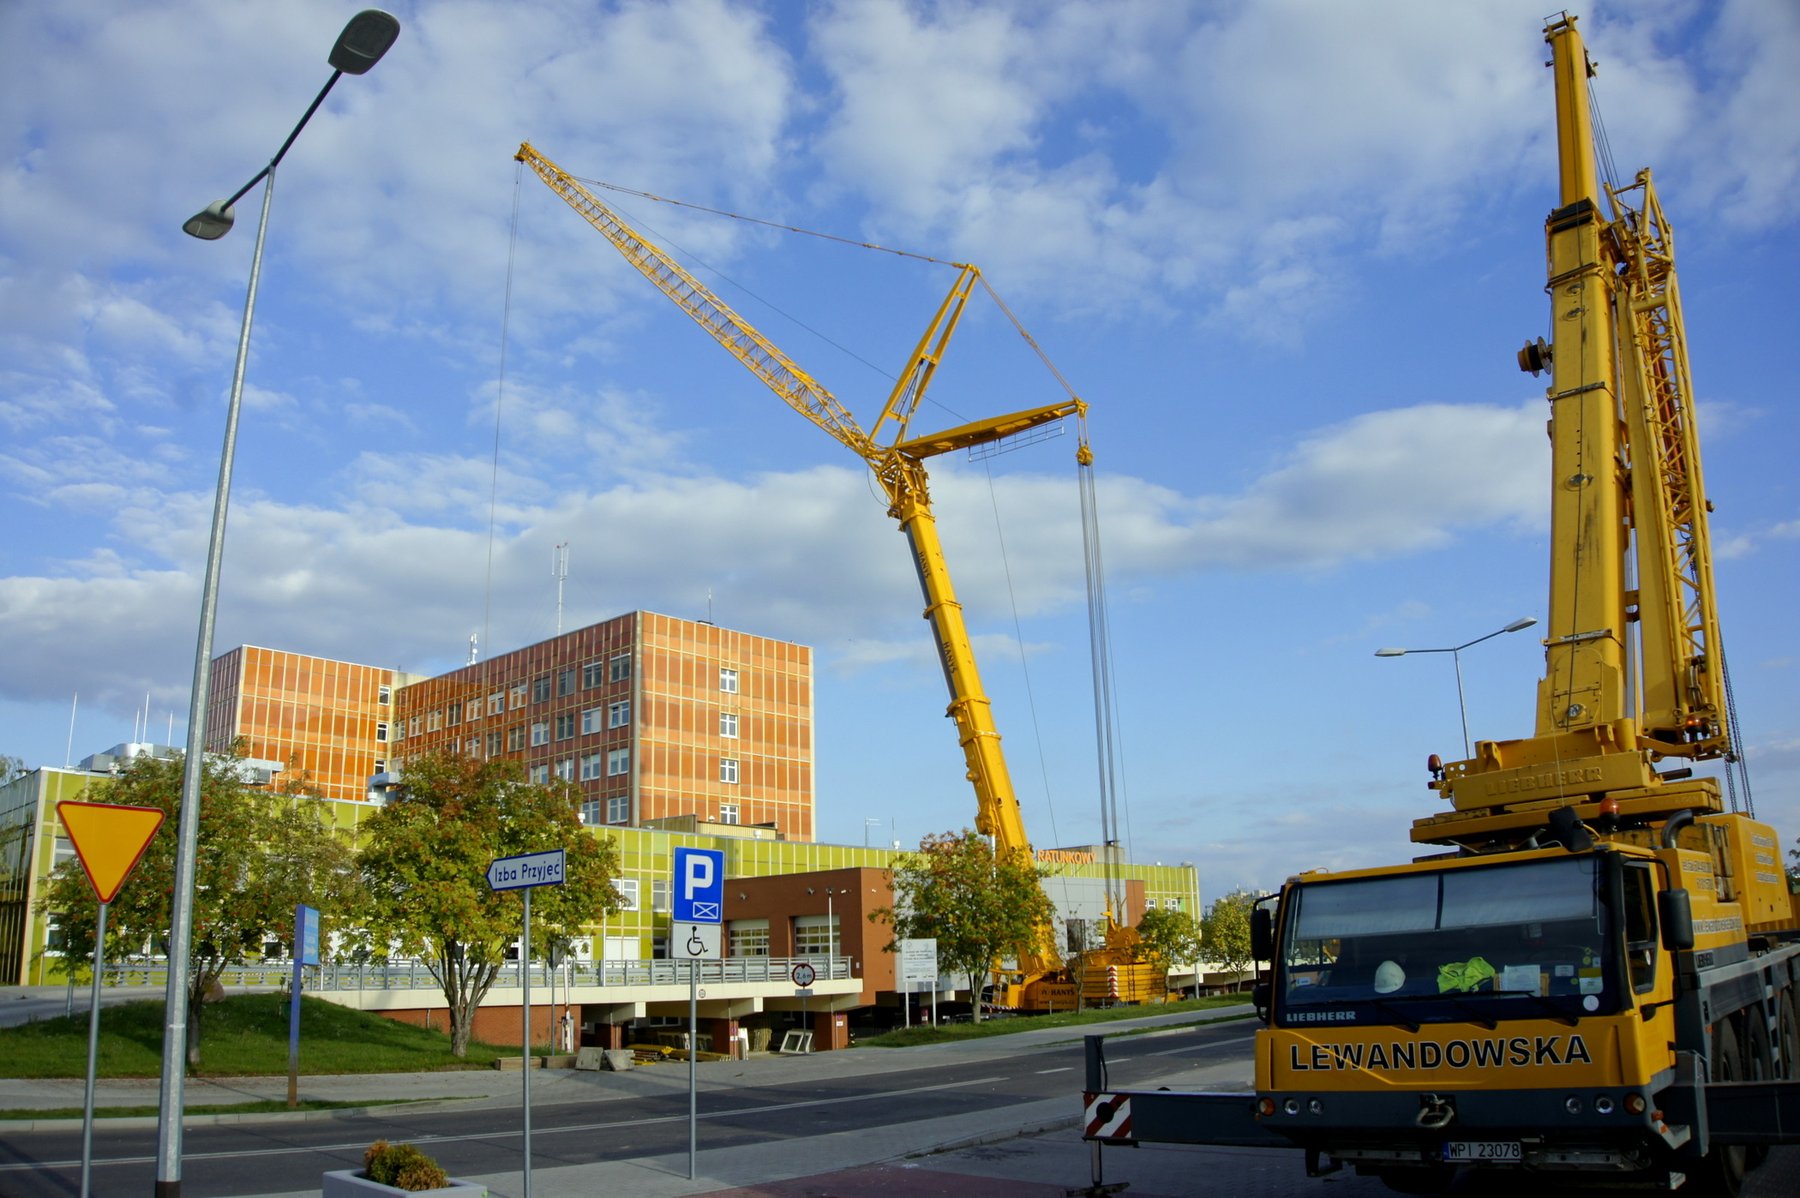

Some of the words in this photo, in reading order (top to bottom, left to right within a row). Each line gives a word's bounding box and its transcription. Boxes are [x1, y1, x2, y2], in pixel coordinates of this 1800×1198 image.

[919, 551, 932, 579] HANYS
[943, 641, 957, 674] HANYS
[1486, 766, 1603, 796] LIEBHERR
[494, 867, 517, 882] Izba
[521, 858, 560, 881] Przyjęć
[1037, 849, 1096, 865] RATUNKOWY
[684, 854, 714, 900] P
[1286, 1010, 1356, 1022] LIEBHERR
[1289, 1034, 1593, 1072] LEWANDOWSKA
[1449, 1143, 1472, 1157] WPI
[1478, 1143, 1520, 1158] 23078
